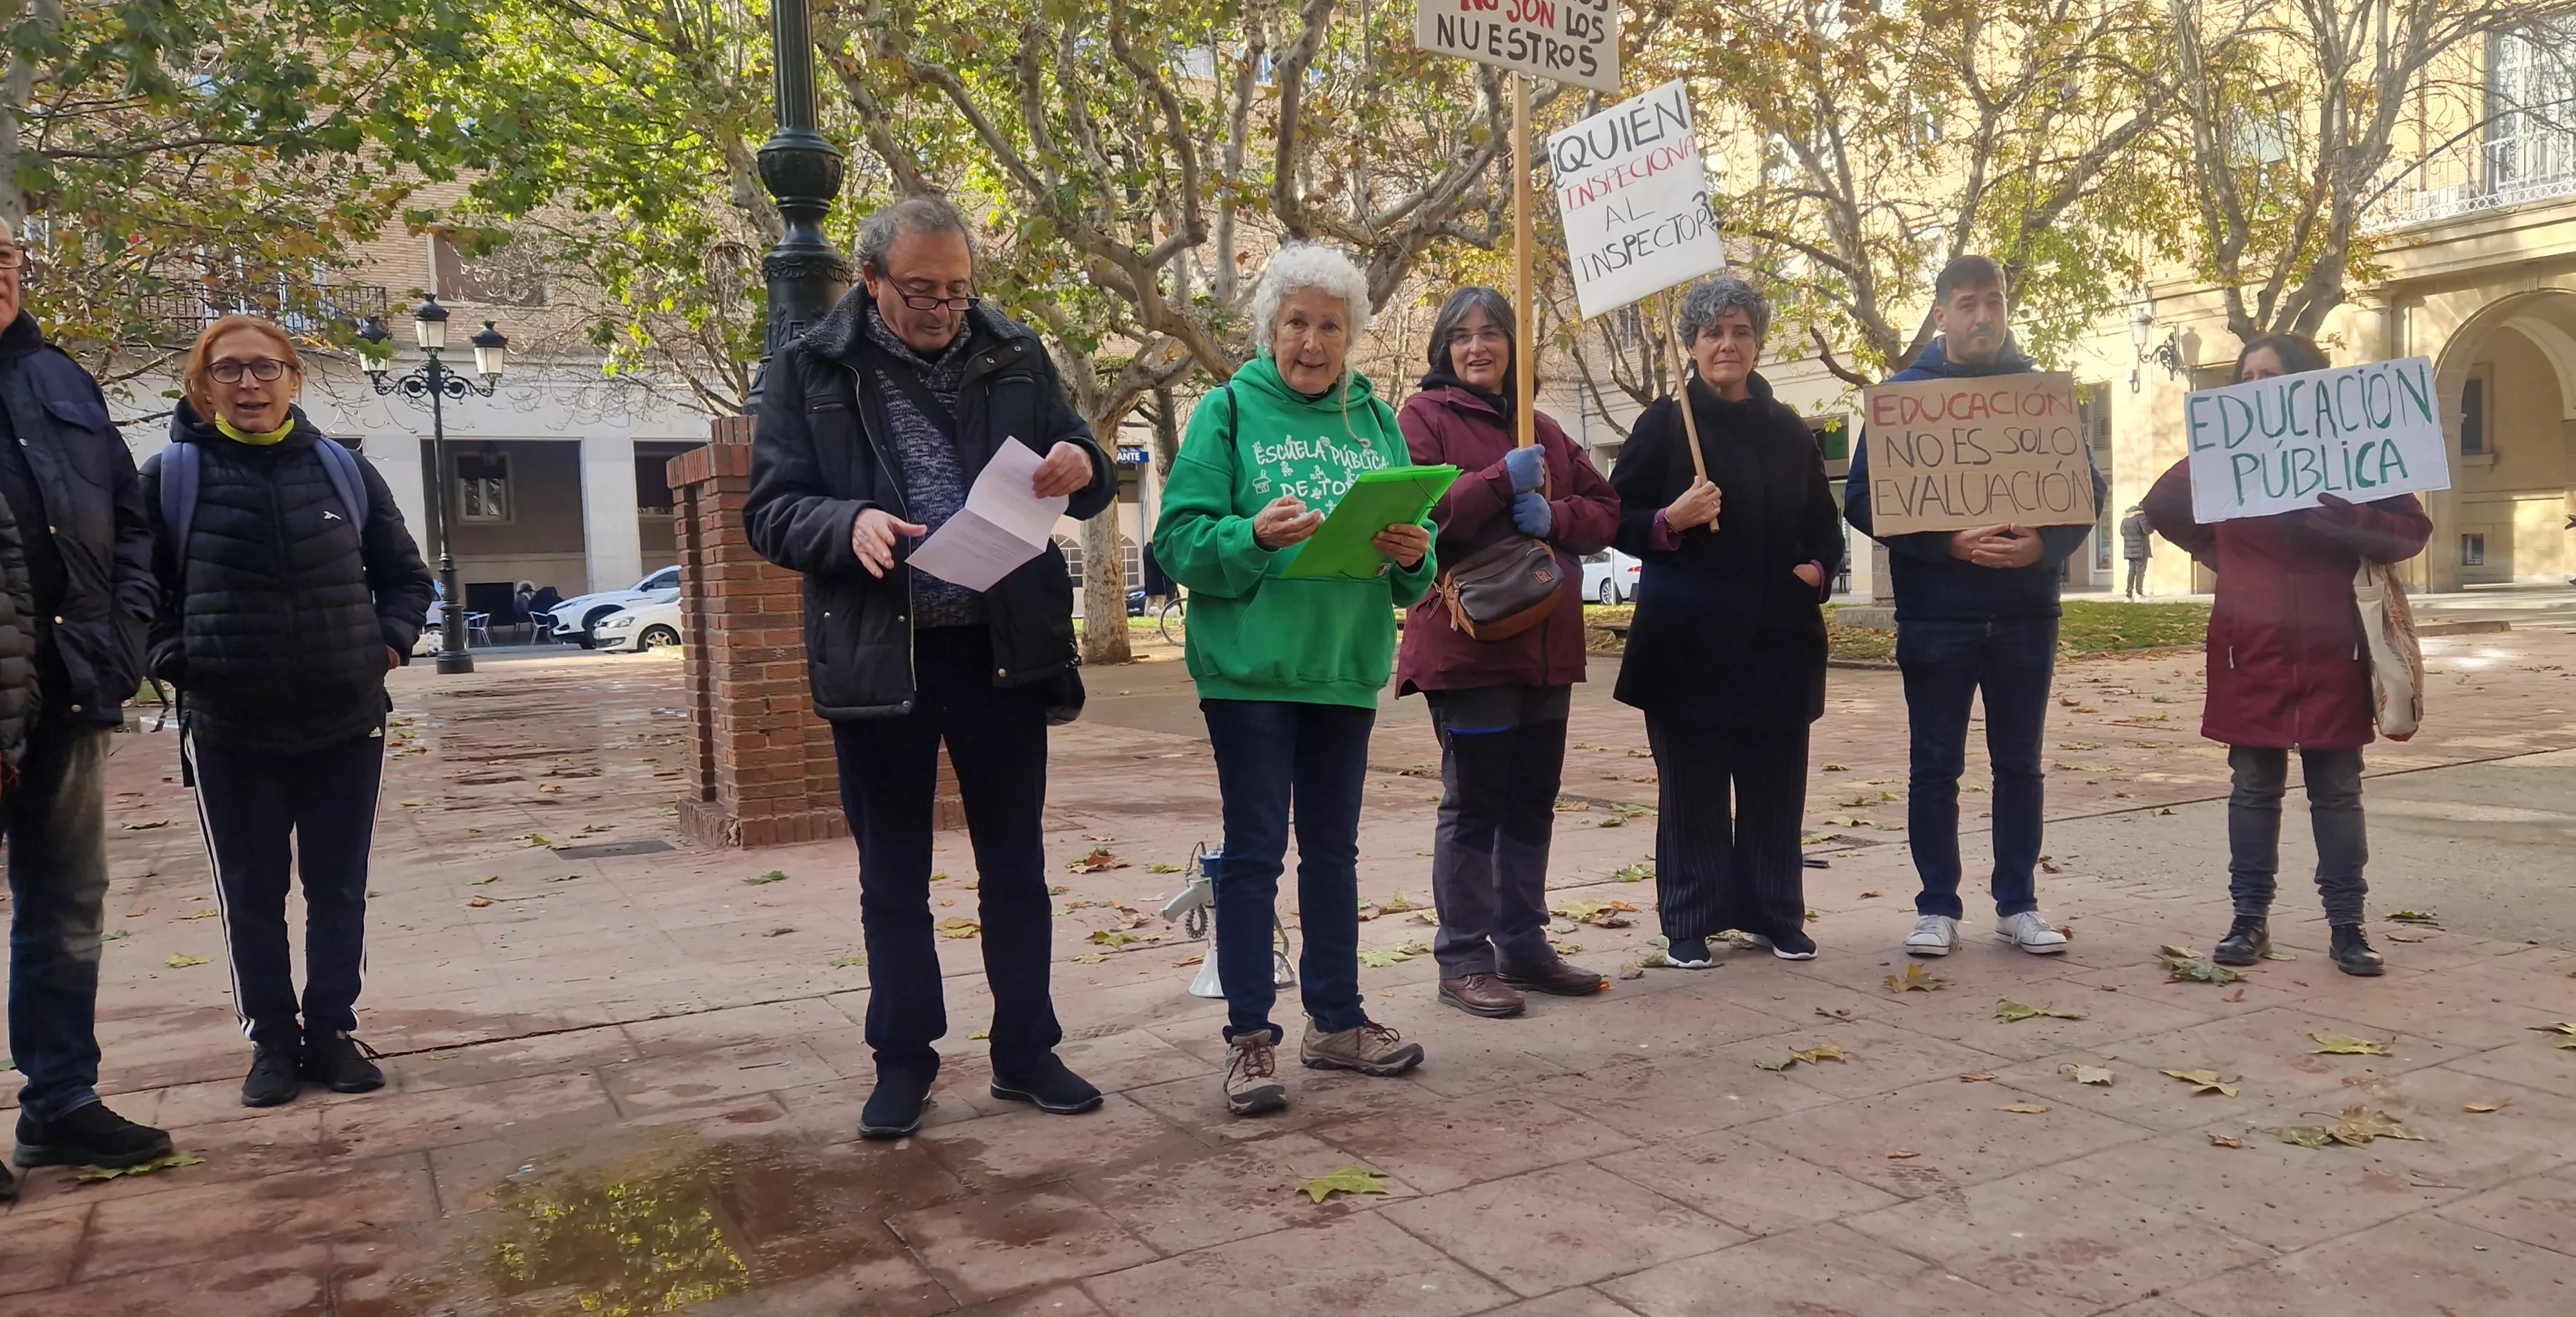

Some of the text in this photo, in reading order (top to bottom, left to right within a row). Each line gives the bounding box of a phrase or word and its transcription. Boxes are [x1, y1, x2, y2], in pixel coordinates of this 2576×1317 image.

[1506, 0, 1604, 43] SON LOS
[1438, 13, 1597, 77] NUESTROS
[1562, 135, 1696, 214] INSPECIONA
[1607, 197, 1656, 232] AL
[1575, 190, 1717, 285] INSPECTOR?
[1872, 383, 2073, 427] EDUCACIÓN
[2190, 363, 2432, 452] EDUCACIÓN
[1117, 452, 1140, 461] ANTE
[1254, 440, 1389, 470] ESCUELA PÚBLICA
[1885, 426, 2078, 468] NO ES SOLO
[1280, 477, 1352, 497] DE TO
[1875, 460, 2093, 517] EVALUACIÓN
[2230, 438, 2408, 507] PÚBLICA
